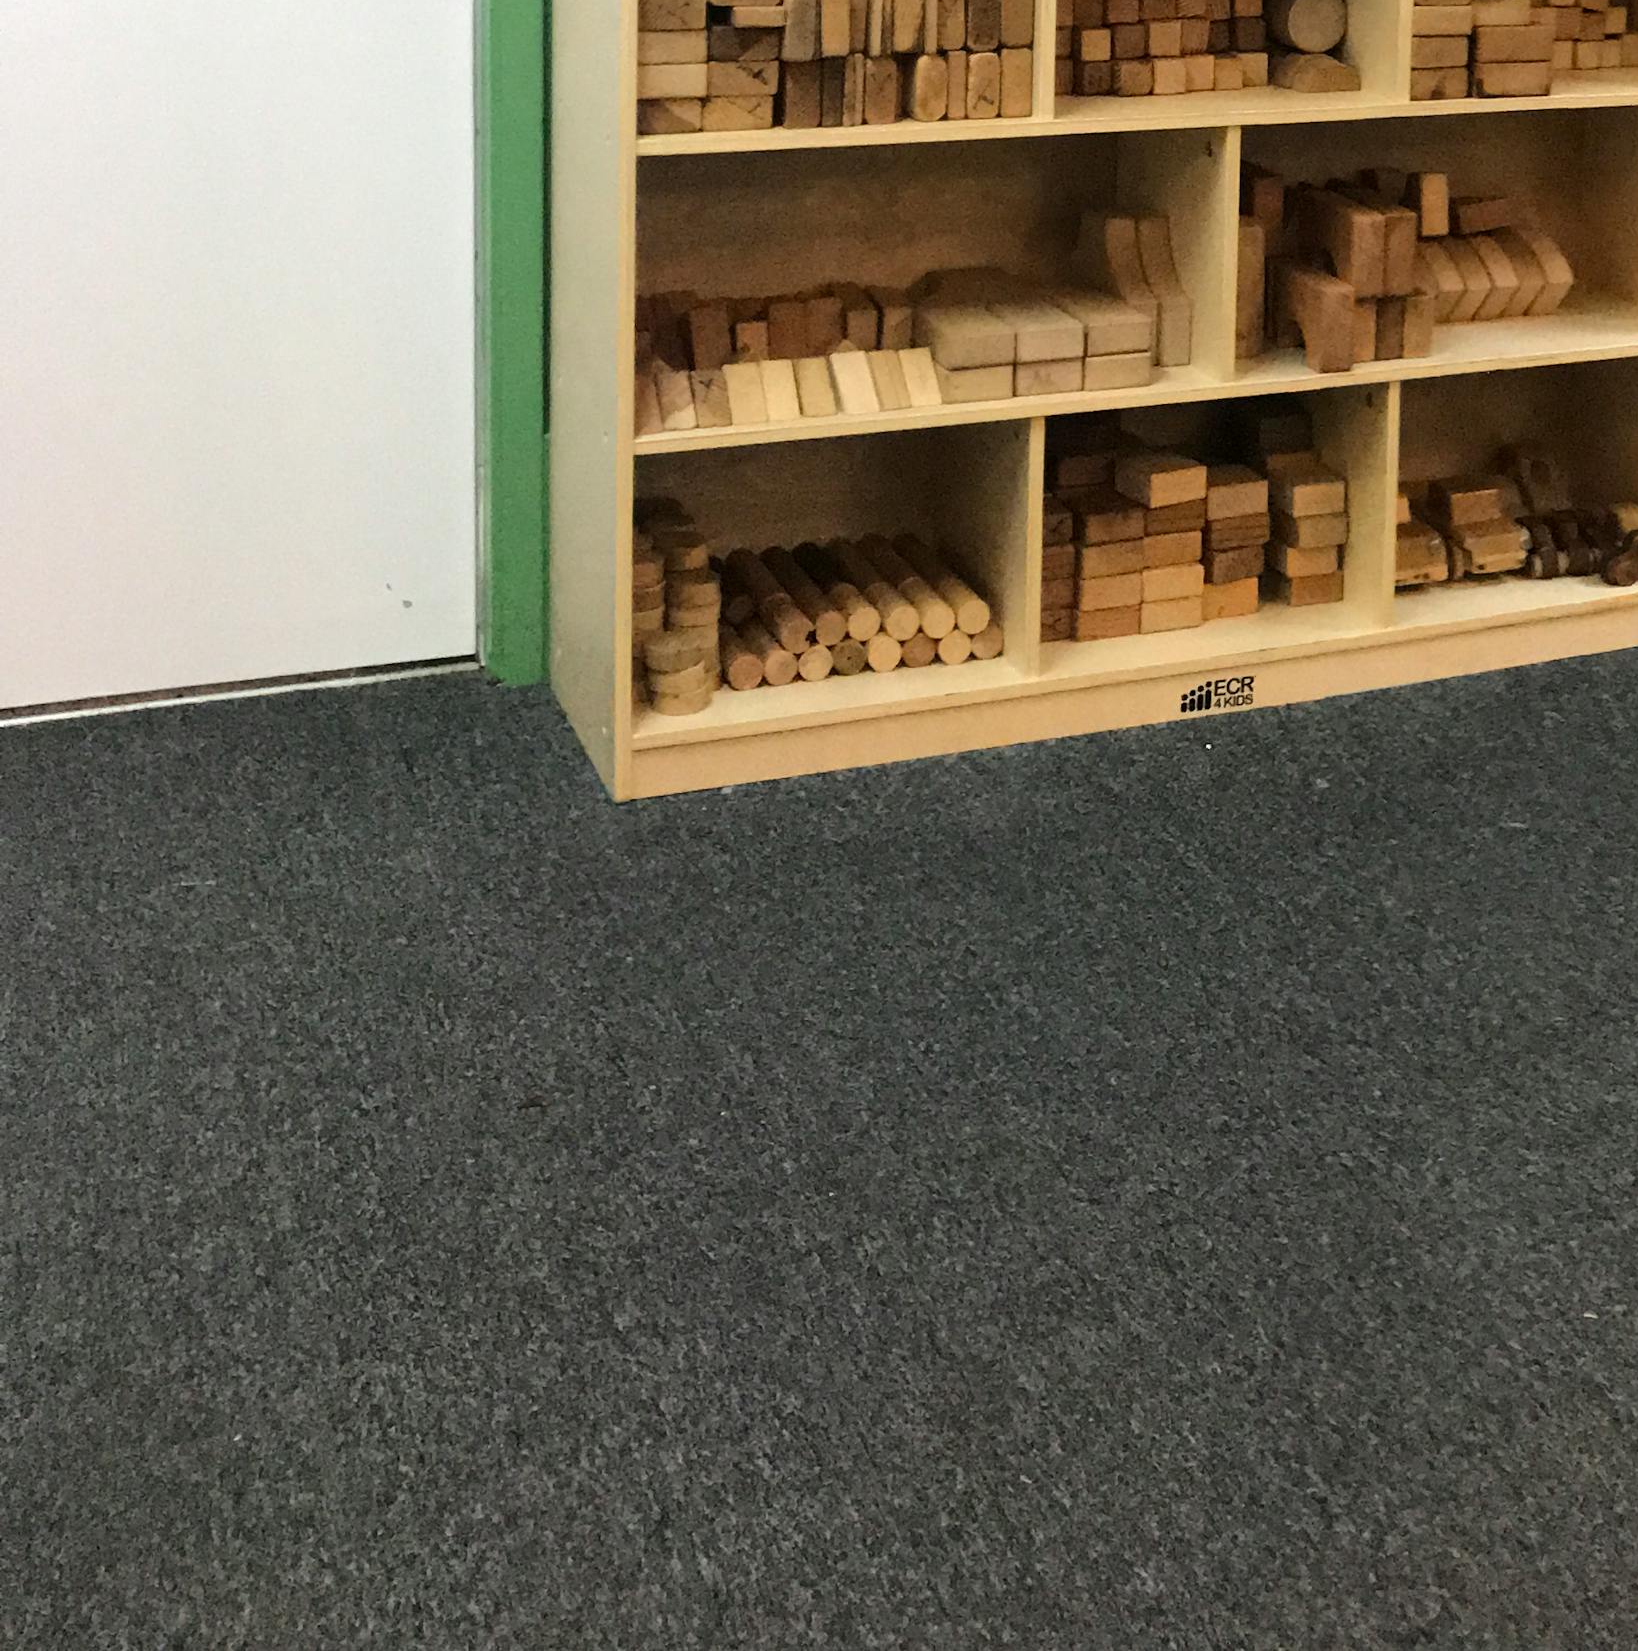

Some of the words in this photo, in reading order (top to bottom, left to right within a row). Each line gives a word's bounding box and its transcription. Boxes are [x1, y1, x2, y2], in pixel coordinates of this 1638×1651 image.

[1214, 676, 1255, 697] ECR
[1214, 697, 1222, 709] 4
[1223, 694, 1254, 709] KIDS
